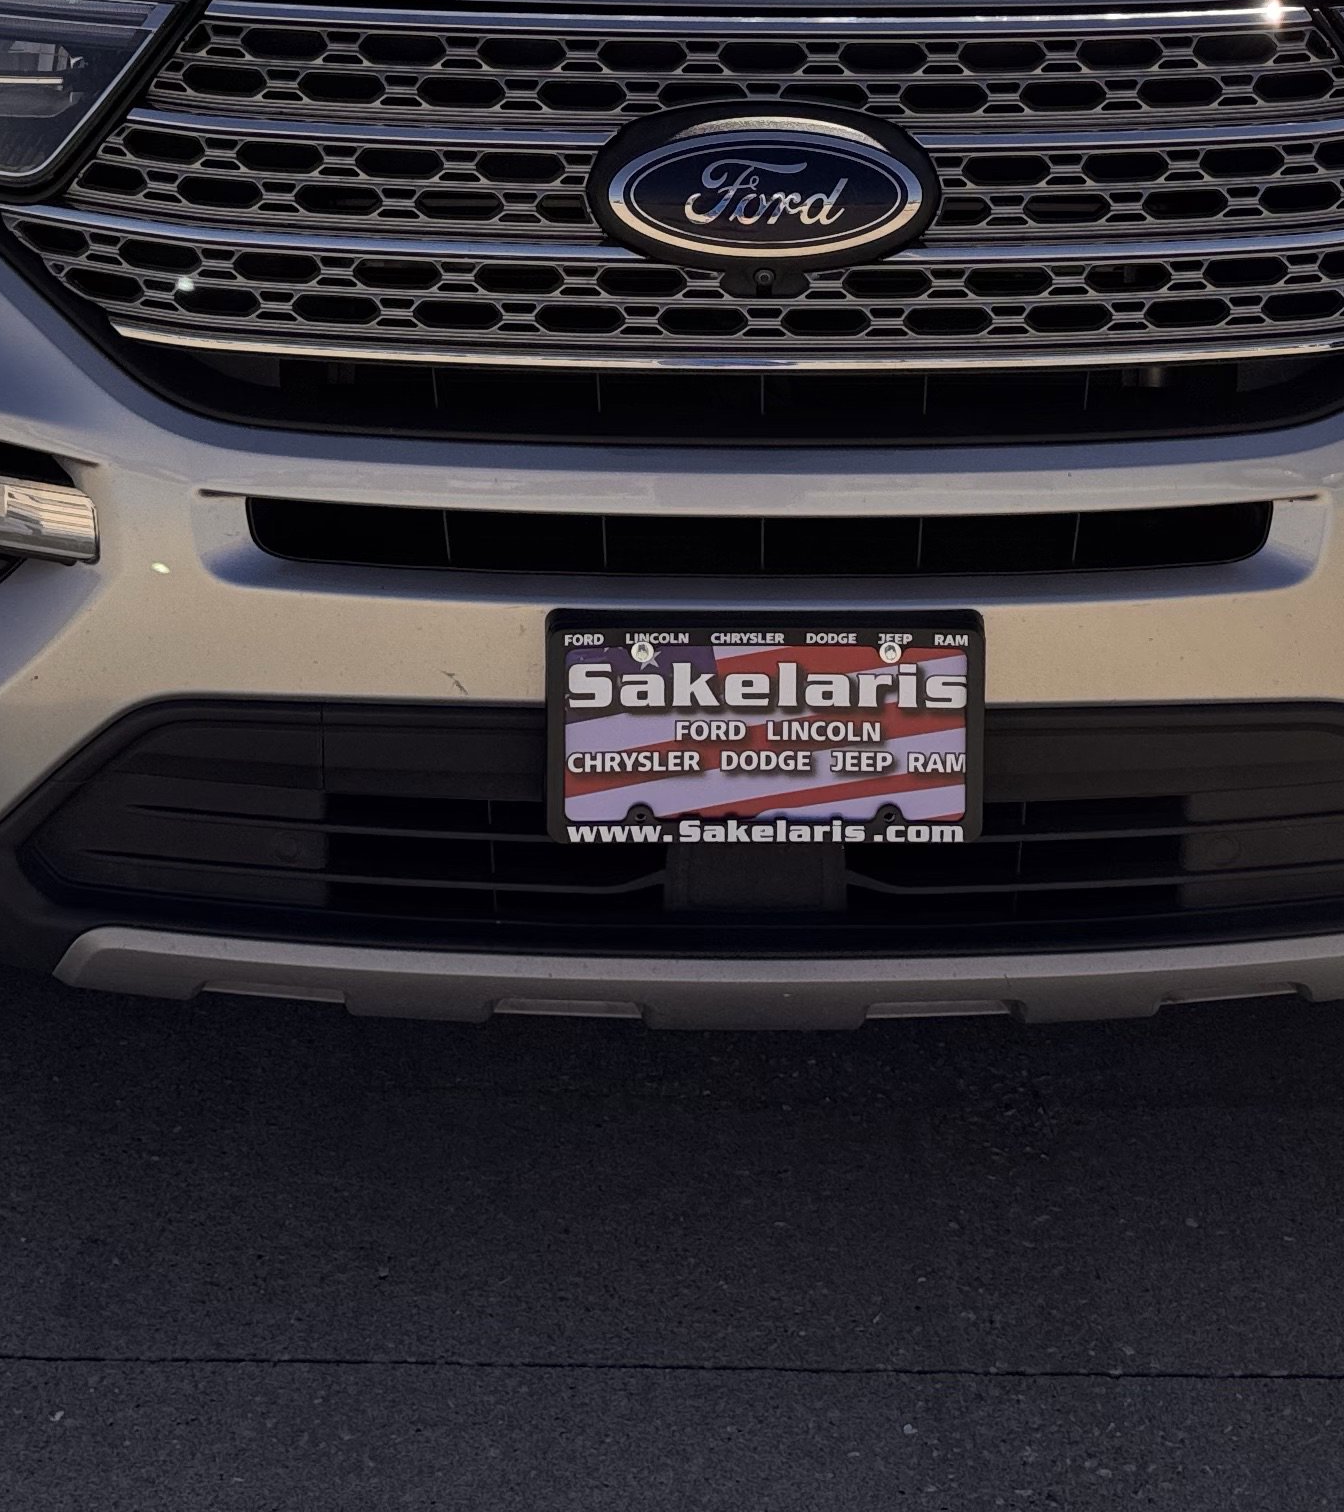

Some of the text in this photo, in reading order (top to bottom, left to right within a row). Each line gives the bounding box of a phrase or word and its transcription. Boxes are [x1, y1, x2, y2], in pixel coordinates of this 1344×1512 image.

[684, 158, 849, 226] Ford
[564, 632, 969, 647] FORD LINCOLN CHRYSLER DODGE JEEP RAM
[567, 661, 968, 710] Sakelaris
[675, 720, 882, 743] FORD LINCOLN
[566, 750, 967, 774] CHRYSLER DODGE JEEP RAM
[566, 820, 965, 843] www.Sakelaris.com
